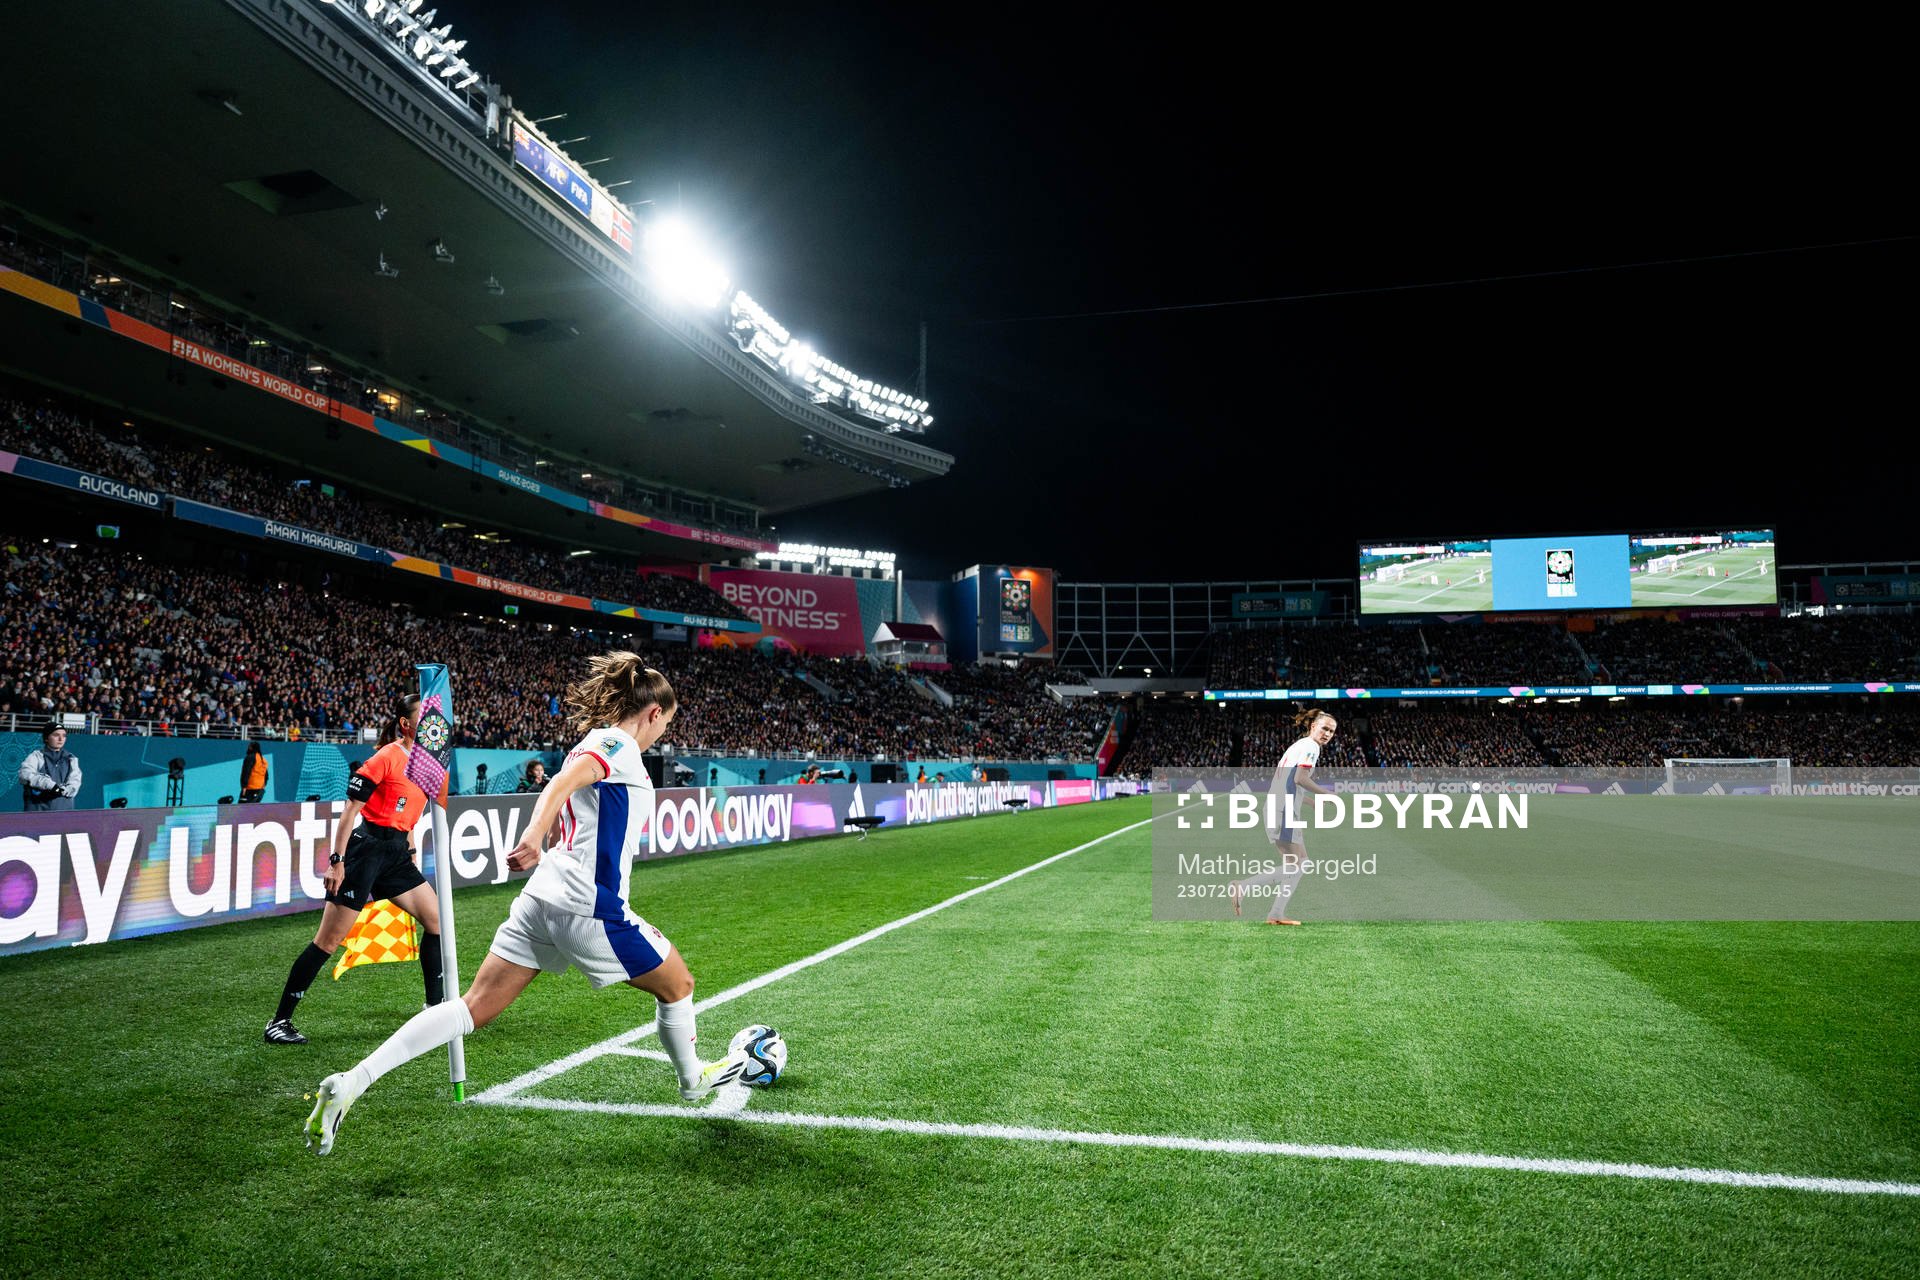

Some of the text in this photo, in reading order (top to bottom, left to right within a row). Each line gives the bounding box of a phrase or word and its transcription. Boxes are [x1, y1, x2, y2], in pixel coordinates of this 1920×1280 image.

[571, 181, 588, 205] FIFA
[172, 339, 327, 409] FIFA WOMEN'S WORLD CUP
[80, 475, 159, 506] AUCKLAND
[301, 531, 358, 555] MAKAURAU
[476, 576, 492, 590] FIFA
[723, 582, 818, 608] BEYOND
[1334, 780, 1367, 794] play
[1370, 780, 1399, 793] until
[1402, 780, 1436, 794] they
[1512, 782, 1558, 794] away
[1811, 783, 1846, 796] until
[1850, 783, 1888, 796] they
[906, 783, 932, 825] play
[935, 782, 957, 817] until
[957, 782, 977, 816] they
[169, 801, 363, 917] unti
[648, 786, 718, 854] look
[723, 793, 792, 844] away
